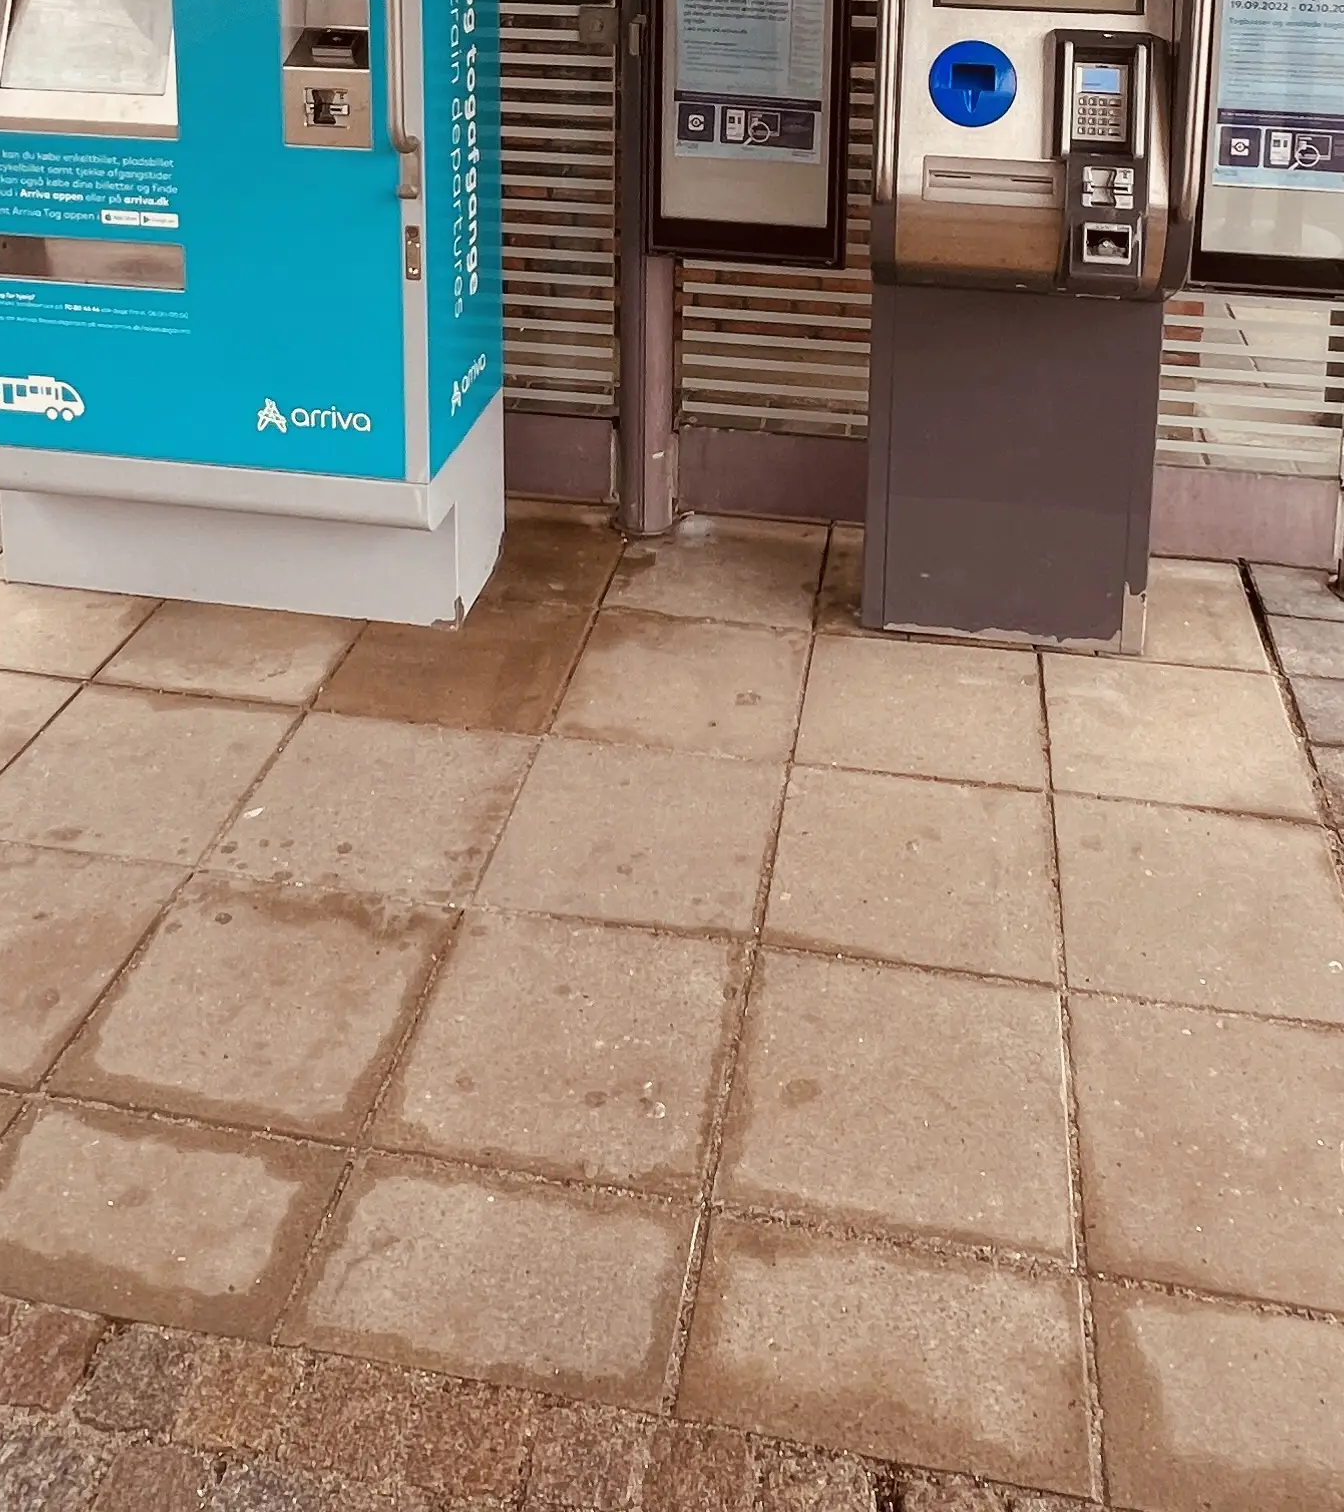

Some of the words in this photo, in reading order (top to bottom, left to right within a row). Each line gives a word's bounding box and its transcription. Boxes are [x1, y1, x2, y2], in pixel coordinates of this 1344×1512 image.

[1230, 0, 1288, 12] 19.09.2022
[2, 150, 20, 159] kan
[22, 151, 36, 160] du
[47, 166, 73, 175] samt
[464, 43, 479, 296] togafgange
[0, 175, 18, 184] kan
[20, 177, 44, 187] også
[72, 180, 93, 189] dine
[95, 181, 134, 191] billetter
[136, 185, 149, 194] og
[152, 183, 178, 194] finde
[19, 189, 50, 200] Arriva
[52, 192, 84, 202] appen
[86, 193, 106, 202] eller
[108, 194, 121, 204] på
[123, 196, 169, 207] arriva.dk
[12, 206, 41, 217] Arriva
[44, 208, 61, 220] Tog
[64, 211, 94, 222] appen
[450, 97, 463, 318] departures
[291, 405, 371, 432] arriva
